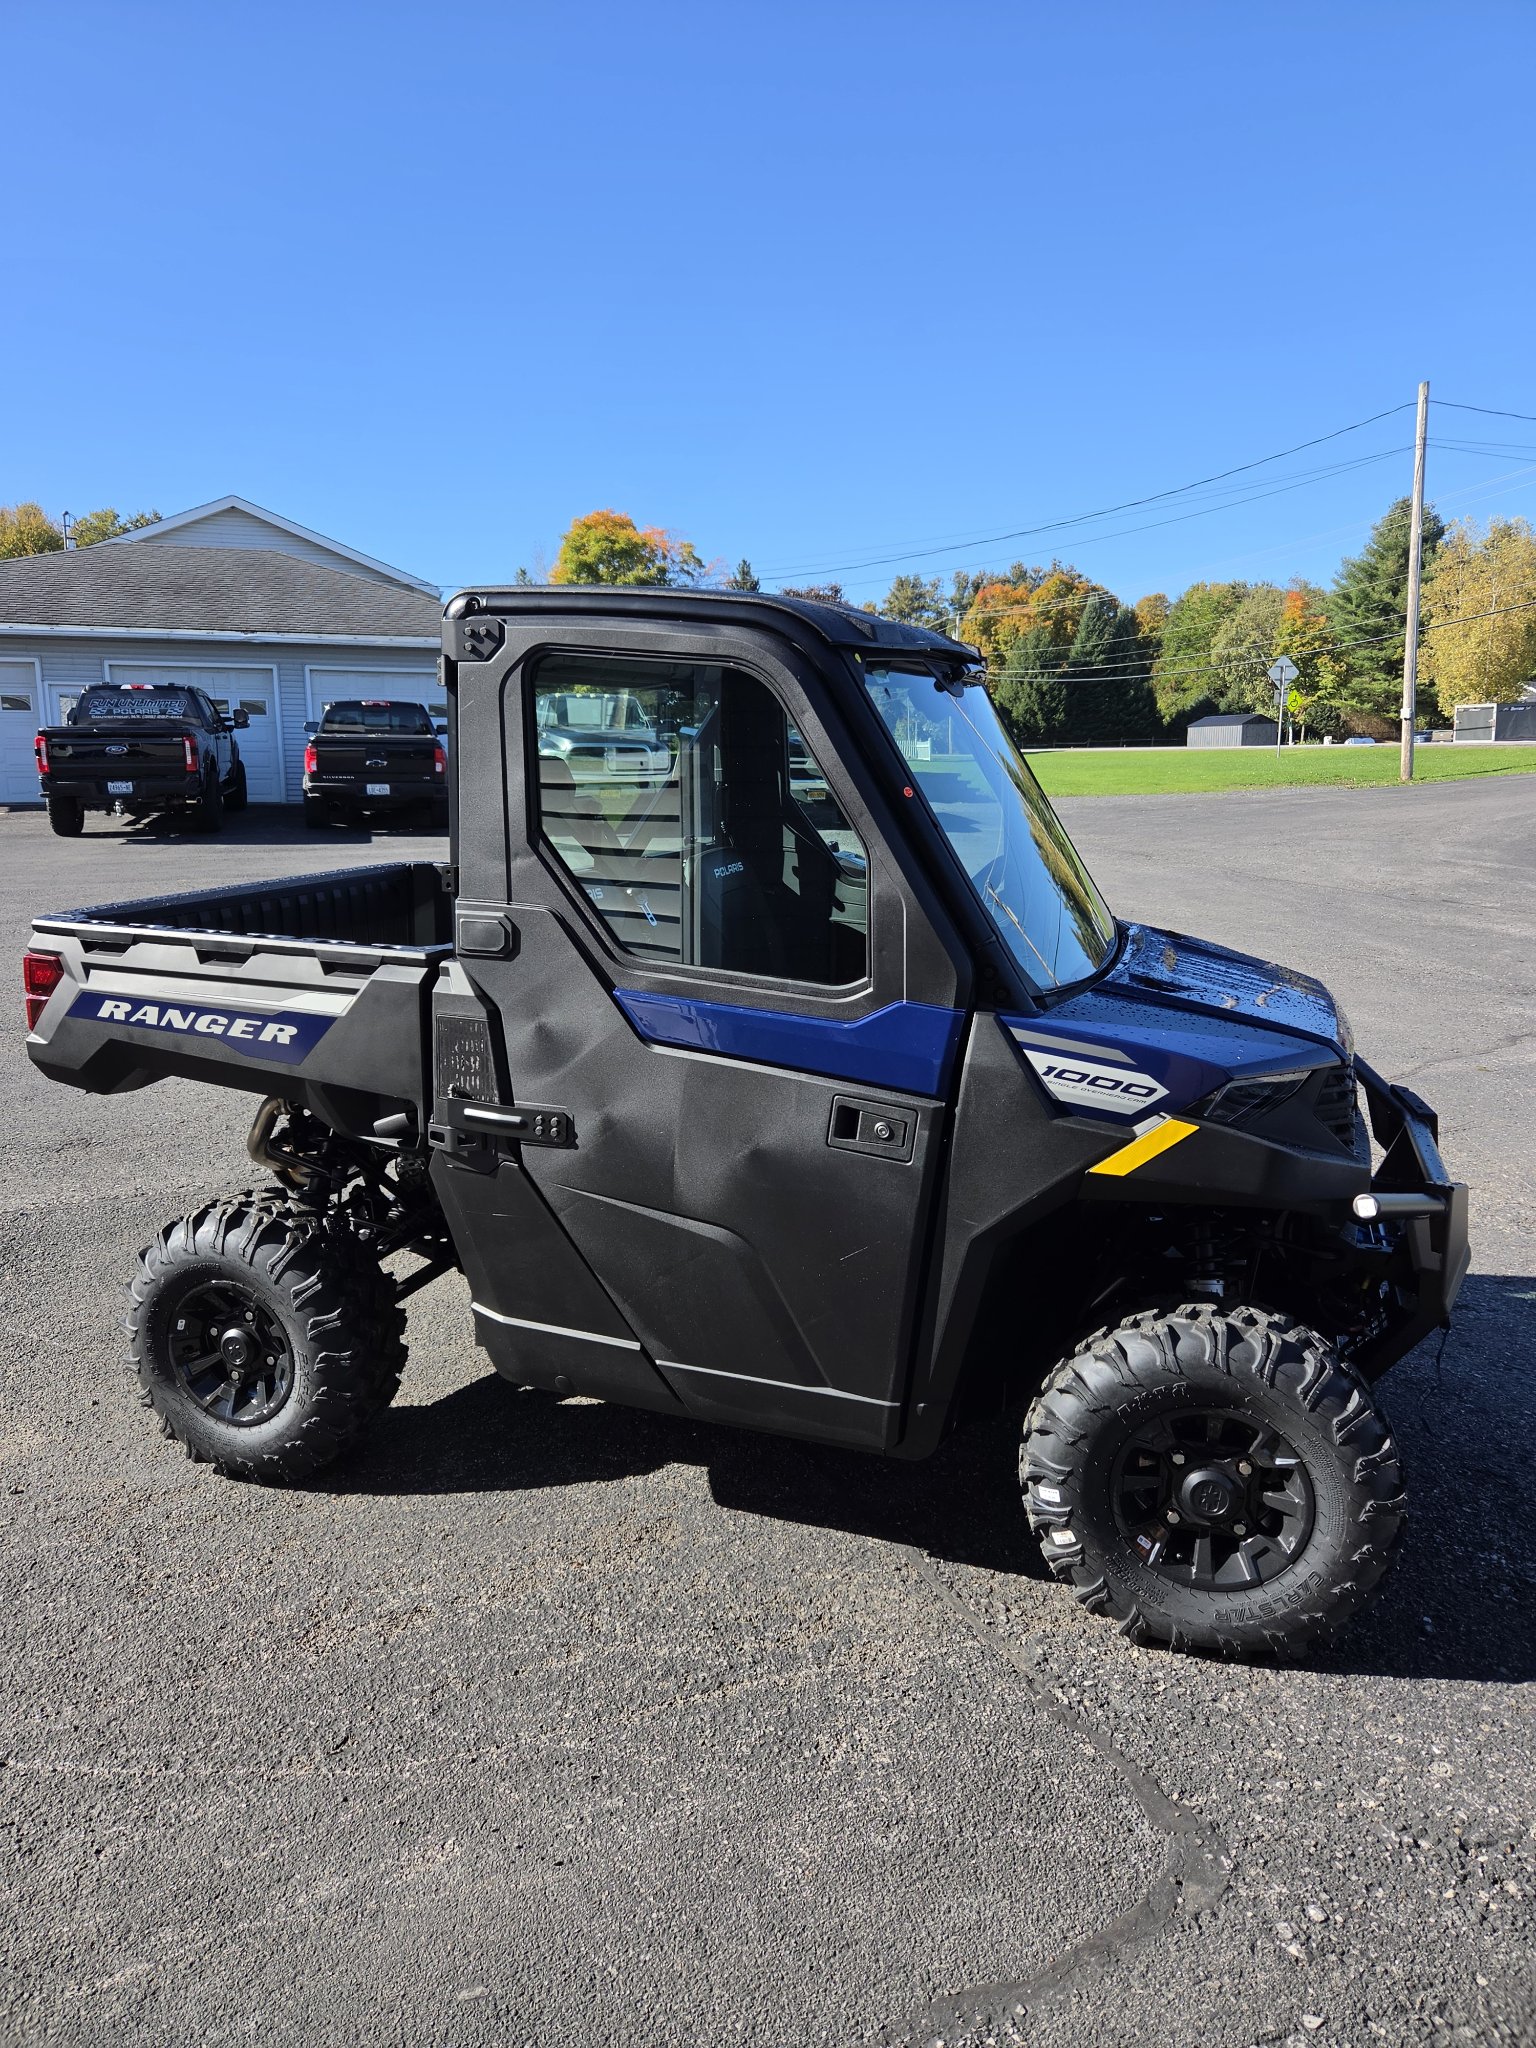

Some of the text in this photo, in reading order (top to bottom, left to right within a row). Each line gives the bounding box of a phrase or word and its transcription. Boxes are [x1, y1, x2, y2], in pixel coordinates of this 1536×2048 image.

[89, 698, 188, 709] FUN UNLIMITED
[714, 861, 744, 878] POLARIS
[97, 1000, 298, 1045] RANGER
[1041, 1065, 1158, 1098] 1000
[1047, 1080, 1147, 1104] SINGLE OVERHEAD CAM
[1213, 1571, 1325, 1622] CARLSTAR
